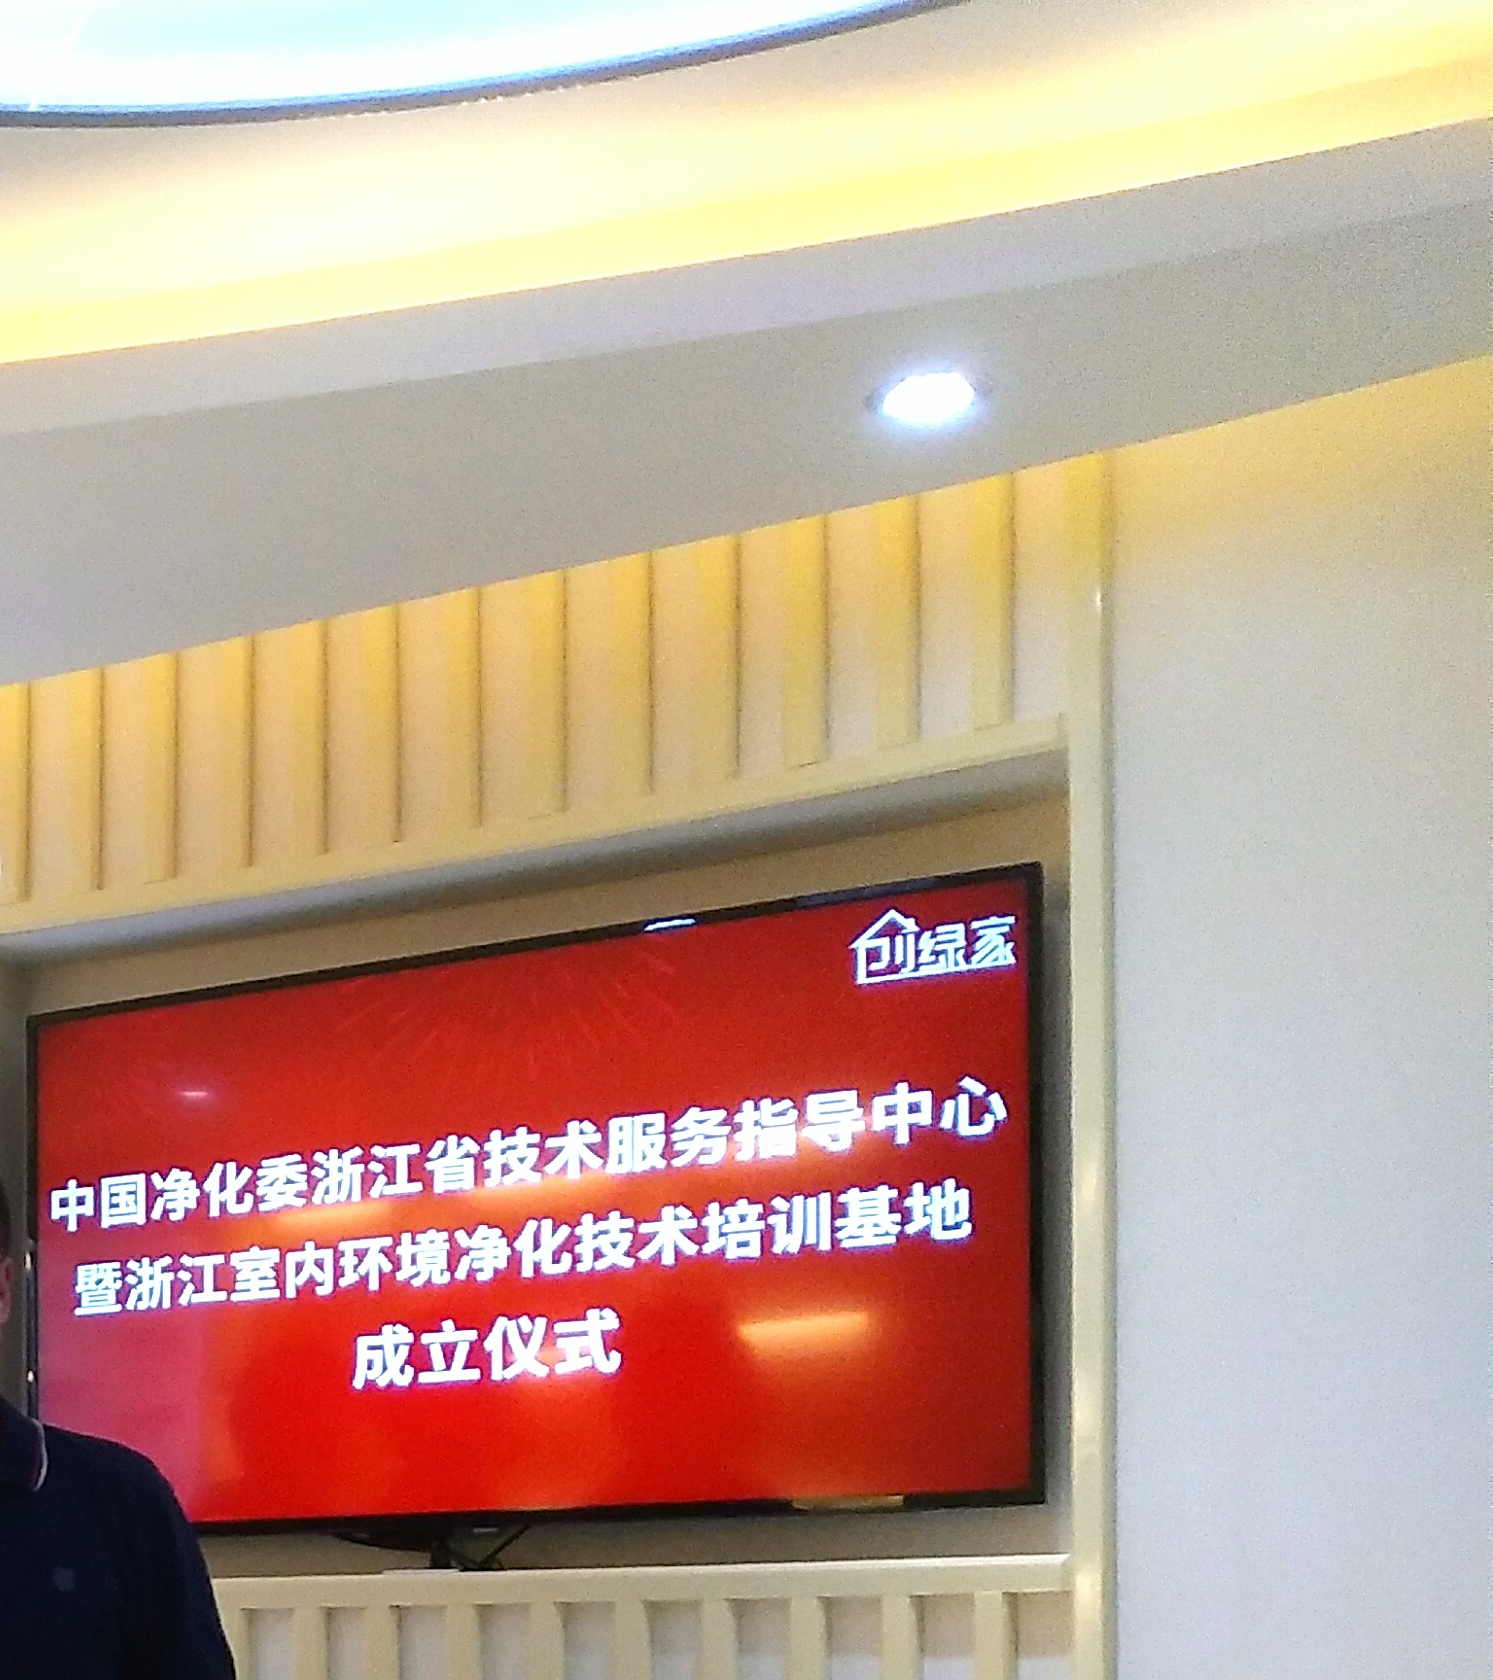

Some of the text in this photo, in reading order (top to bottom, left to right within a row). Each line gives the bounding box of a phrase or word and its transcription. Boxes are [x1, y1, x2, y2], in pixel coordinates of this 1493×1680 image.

[849, 909, 1016, 985] 创绿家
[48, 1075, 1011, 1234] 中国净化委浙江省技术服务指导中心
[73, 1180, 975, 1316] 暨浙江室内环境净化技术培训基地
[351, 1307, 623, 1390] 成立仪式
